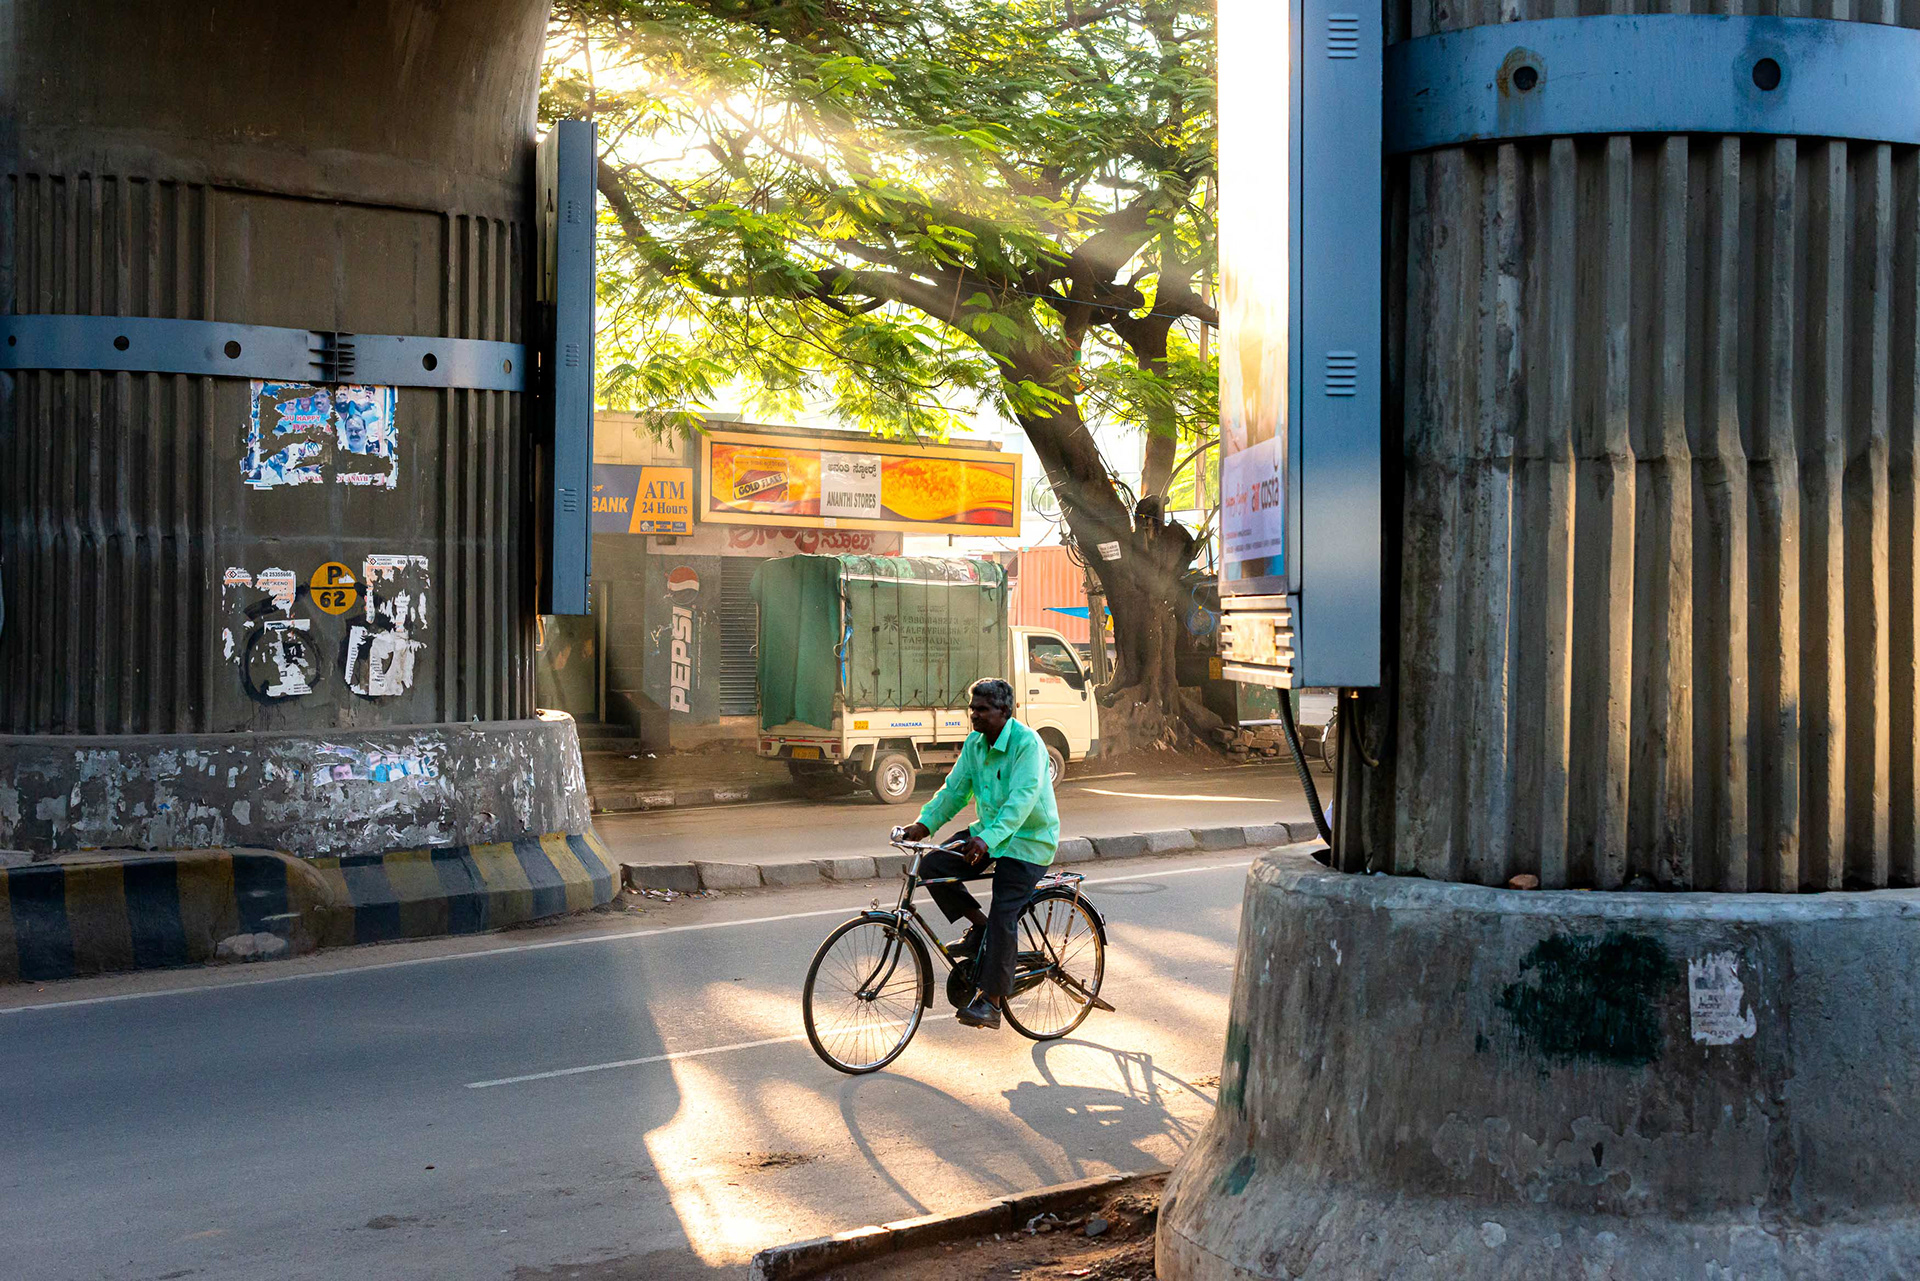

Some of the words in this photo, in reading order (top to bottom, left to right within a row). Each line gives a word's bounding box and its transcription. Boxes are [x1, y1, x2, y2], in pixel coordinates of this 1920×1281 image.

[644, 480, 686, 500] ATM
[738, 482, 760, 496] GOLD
[760, 474, 783, 489] FLAKE
[592, 496, 629, 513] BANK
[641, 501, 654, 513] 24
[657, 502, 688, 514] Hours
[826, 491, 853, 507] ANANTHI
[853, 493, 877, 509] STORES
[327, 566, 342, 585] P
[320, 590, 346, 608] 62
[670, 605, 693, 714] PEPSI
